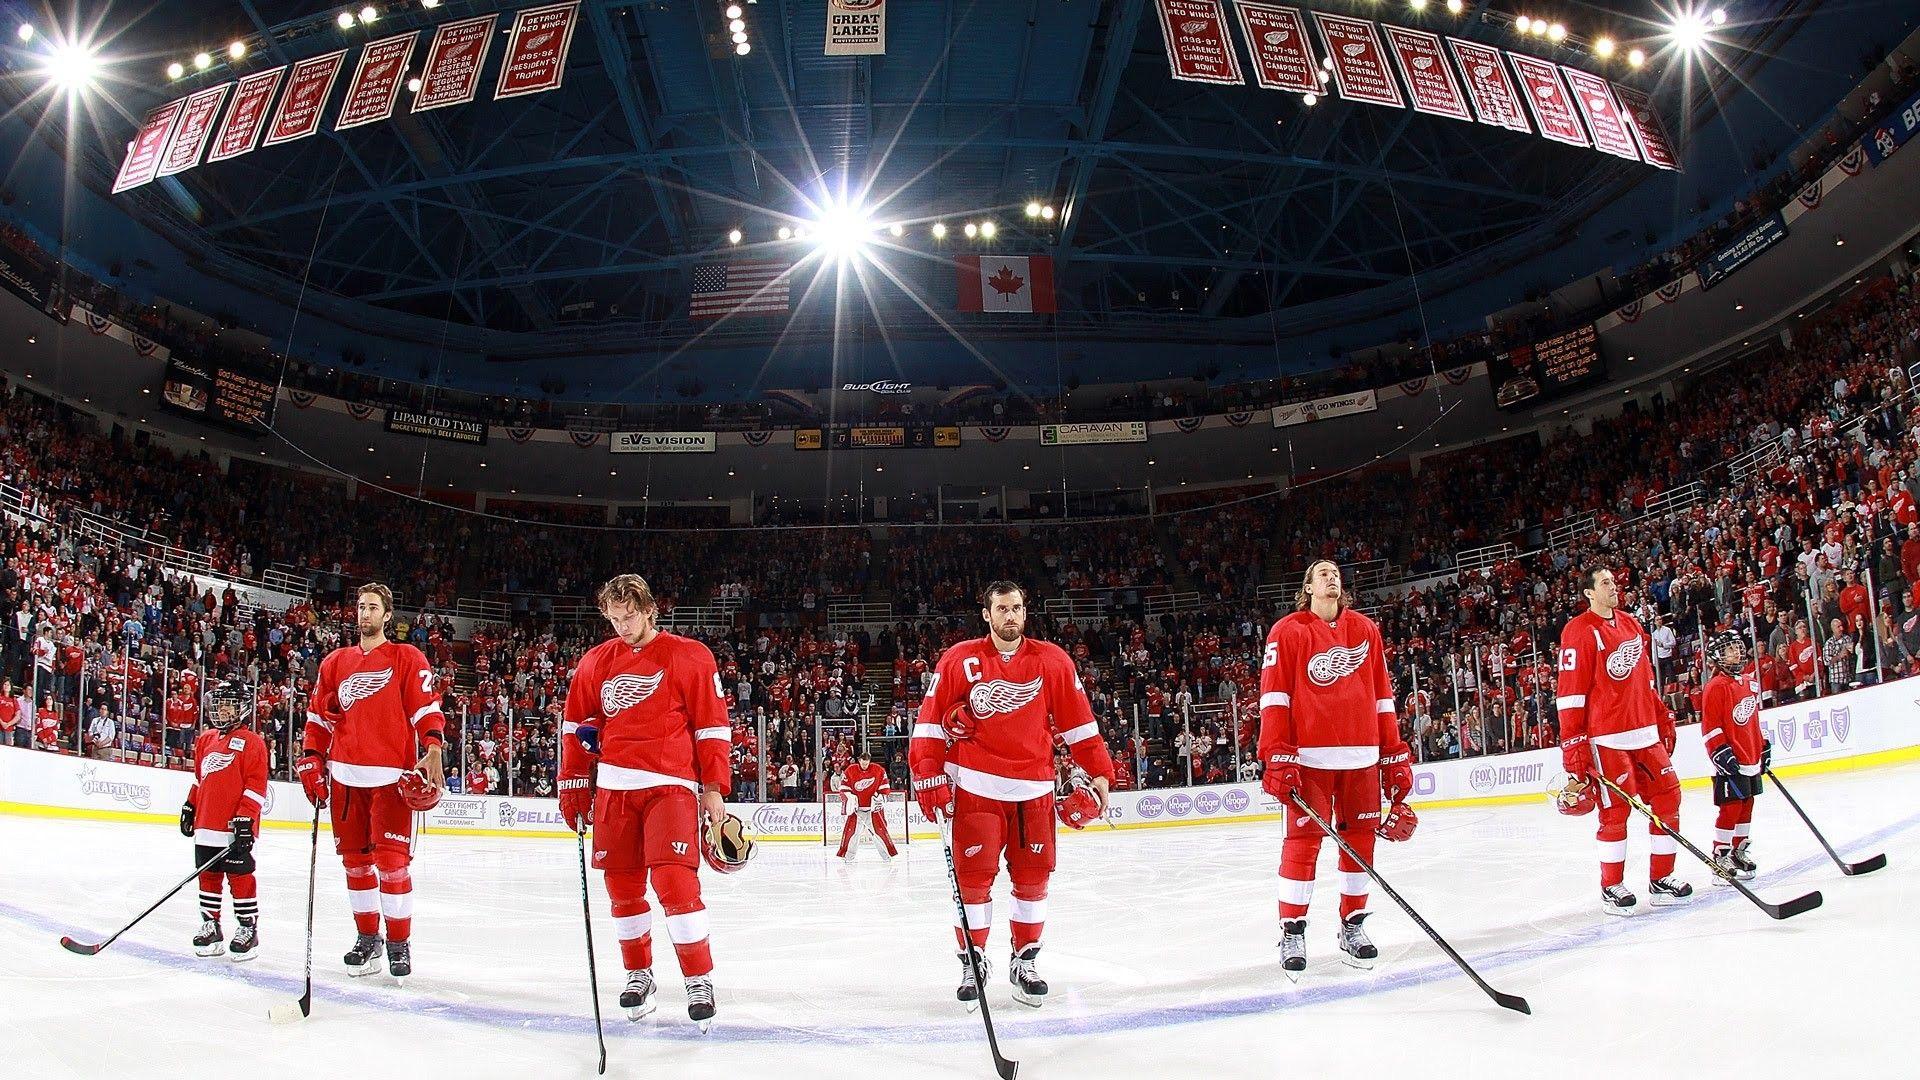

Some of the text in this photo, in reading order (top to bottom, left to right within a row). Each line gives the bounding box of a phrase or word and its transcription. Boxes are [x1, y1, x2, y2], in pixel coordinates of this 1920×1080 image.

[1170, 1, 1209, 11] DETROIT
[527, 12, 564, 25] DETROIT
[832, 14, 880, 24] GREAT
[1189, 10, 1216, 19] WINGS
[1251, 11, 1288, 21] DETROIT
[541, 20, 567, 30] WINGS
[1249, 18, 1295, 30] RED WINGS
[1329, 22, 1363, 34] DETROIT
[447, 25, 483, 38] DETROIT
[832, 25, 879, 36] LAKES
[1328, 30, 1372, 43] RED WINGS
[441, 31, 484, 46] RED WINGS
[1398, 36, 1430, 47] DETROIT
[372, 42, 405, 56] DETROIT
[1181, 45, 1221, 55] CLARENCE
[1398, 43, 1437, 55] RED WINGS
[383, 50, 406, 61] WINGS
[1183, 54, 1223, 64] CAMPBELL
[1263, 53, 1306, 64] CLARENCE
[301, 62, 332, 75] DETROIT
[428, 66, 474, 80] CONFERENCE
[436, 61, 471, 73] WESTERN
[1194, 63, 1217, 72] BOWL
[1266, 62, 1307, 73] CAMPBELL
[1345, 65, 1381, 77] CENTRAL
[312, 69, 332, 79] WINGS
[515, 69, 547, 80] TROPHY
[1278, 72, 1303, 82] BOWL
[1347, 74, 1384, 86] DIVISION
[432, 75, 466, 87] REGULAR
[1416, 79, 1448, 90] CENTRAL
[357, 87, 388, 99] CENTRAL
[432, 82, 462, 94] SEASON
[1346, 83, 1392, 96] CHAMPIONS
[1418, 87, 1452, 99] DIVISION
[423, 87, 467, 102] CHAMPIONS
[353, 95, 387, 108] DIVISION
[1418, 96, 1460, 109] CHAMPIONS
[346, 102, 387, 118] CHAMPIONS
[282, 117, 307, 128] TROPHY
[1535, 324, 1593, 352] God keep our land
[1564, 341, 1578, 351] and
[1545, 352, 1597, 377] stand on guard
[217, 368, 275, 394] God keep our land
[1558, 373, 1569, 383] for
[241, 386, 255, 395] and
[842, 383, 870, 391] BUD
[1329, 399, 1356, 409] WINGS!
[393, 411, 483, 433] LIPARI OLD TYME
[1060, 424, 1123, 434] CARAVAN
[438, 429, 452, 438] DELI
[452, 431, 480, 442] FAVORITE
[655, 437, 705, 445] VISION
[963, 657, 982, 683] C
[1562, 735, 1588, 748] CCM
[1271, 754, 1301, 764] BAU
[1475, 769, 1492, 783] FOX
[1498, 763, 1544, 787] DETROIT
[557, 778, 590, 790] RRIOR
[913, 774, 948, 791] RRIOR
[439, 801, 479, 811] OCKEY FIGHTS
[1169, 797, 1192, 814] Kroger
[1197, 796, 1220, 812] Kroger
[1225, 792, 1248, 809] Kroger
[444, 808, 468, 816] CANCER
[1140, 798, 1164, 816] Kroger
[517, 810, 565, 824] BELLE
[760, 806, 788, 825] Tim
[768, 824, 790, 832] CAFE
[797, 824, 819, 832] BAKE
[820, 824, 842, 832] SOP
